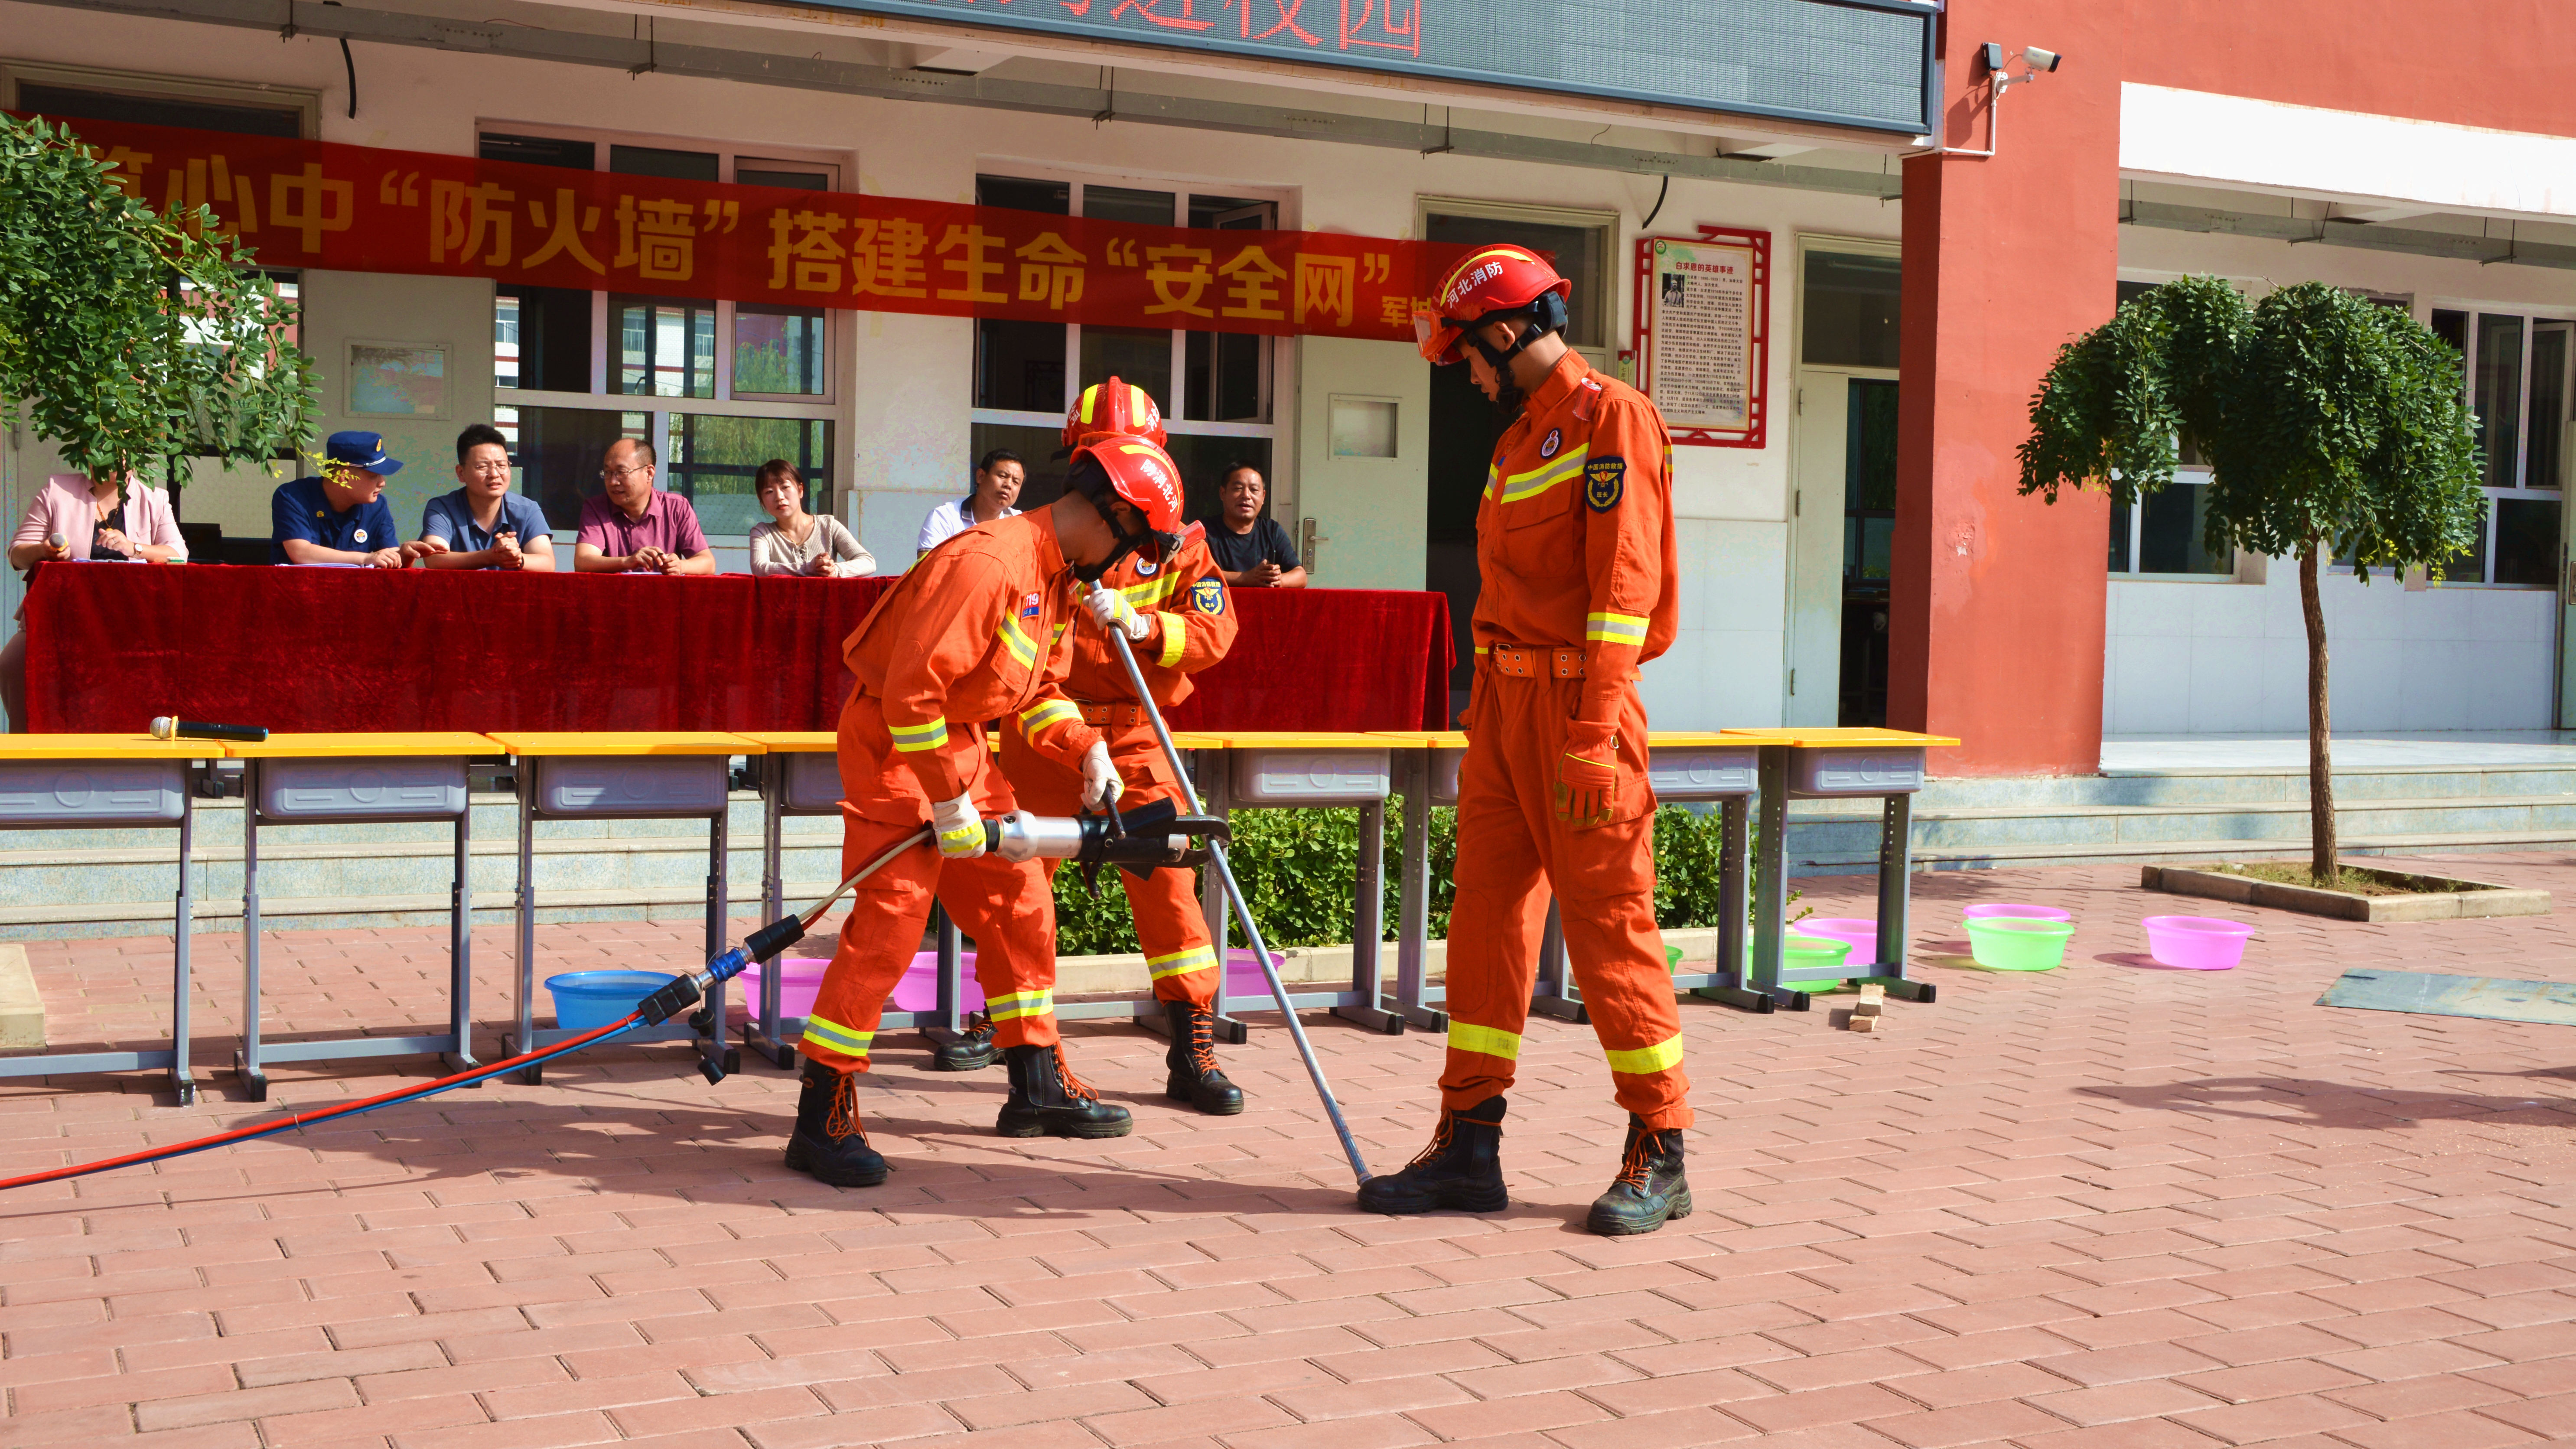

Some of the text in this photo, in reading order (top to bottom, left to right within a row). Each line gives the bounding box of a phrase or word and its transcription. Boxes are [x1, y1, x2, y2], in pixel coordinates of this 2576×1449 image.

[1676, 262, 1733, 274] 白求恩的英雄事迹
[1446, 261, 1503, 309] 河北消防
[1588, 462, 1623, 471] 中国消防救援
[1026, 593, 1039, 606] 119
